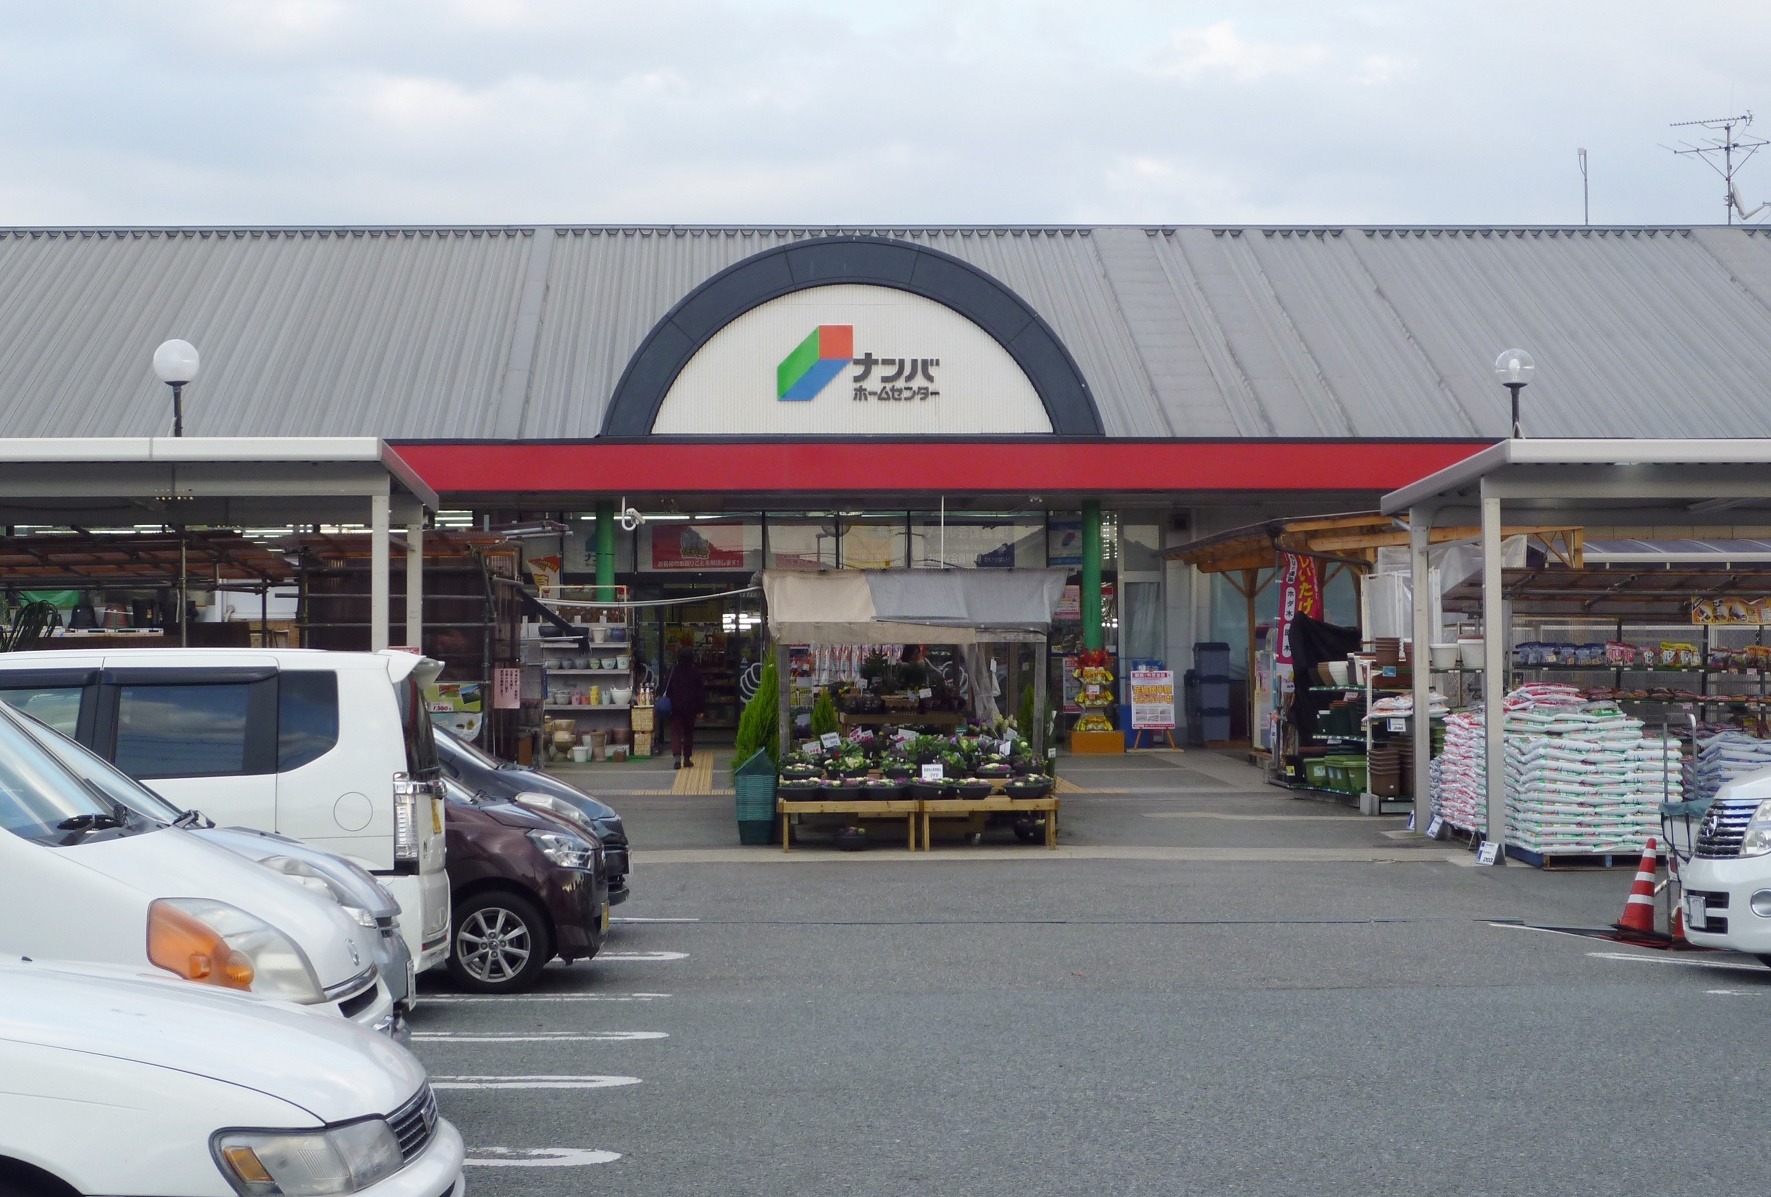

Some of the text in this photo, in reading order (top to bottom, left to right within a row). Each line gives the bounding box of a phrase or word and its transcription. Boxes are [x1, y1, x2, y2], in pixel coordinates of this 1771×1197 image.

[853, 352, 940, 383] ナンバ
[853, 385, 940, 401] ホームセンター
[1298, 554, 1314, 619] しいたけ
